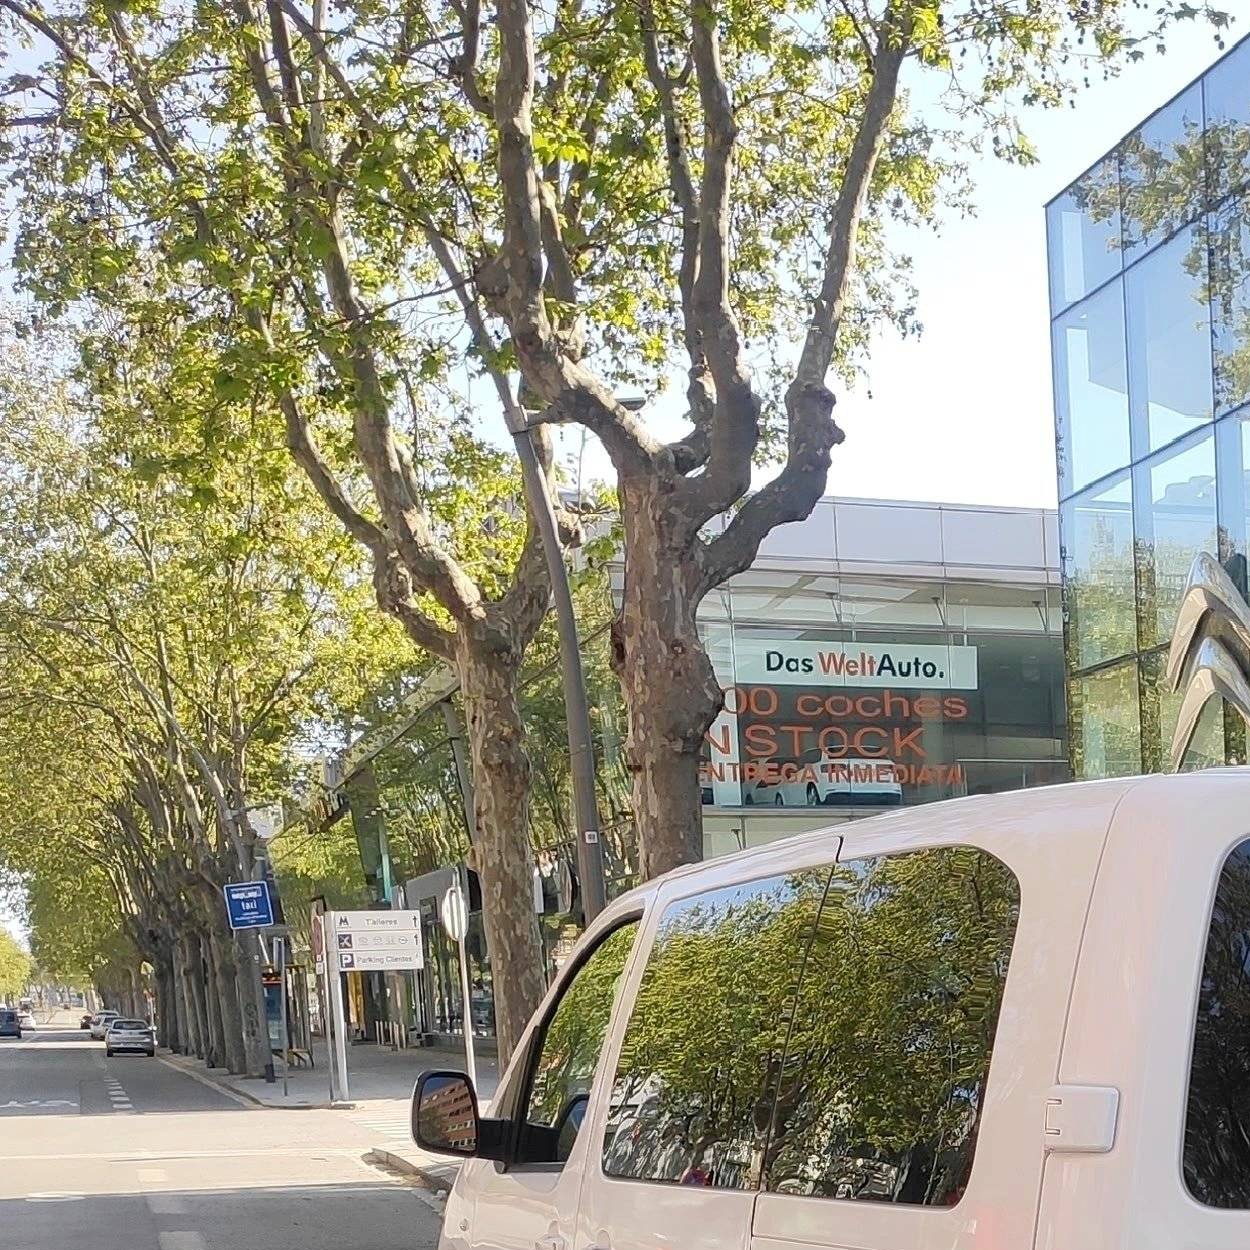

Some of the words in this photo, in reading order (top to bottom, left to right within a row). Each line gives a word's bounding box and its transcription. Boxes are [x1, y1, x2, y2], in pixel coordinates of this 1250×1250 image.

[766, 651, 814, 673] Das
[796, 690, 968, 719] coches
[745, 724, 928, 758] STOCK
[241, 899, 257, 910] taxi
[343, 954, 352, 967] P
[357, 956, 384, 965] Parking
[385, 955, 412, 964] Clientes
